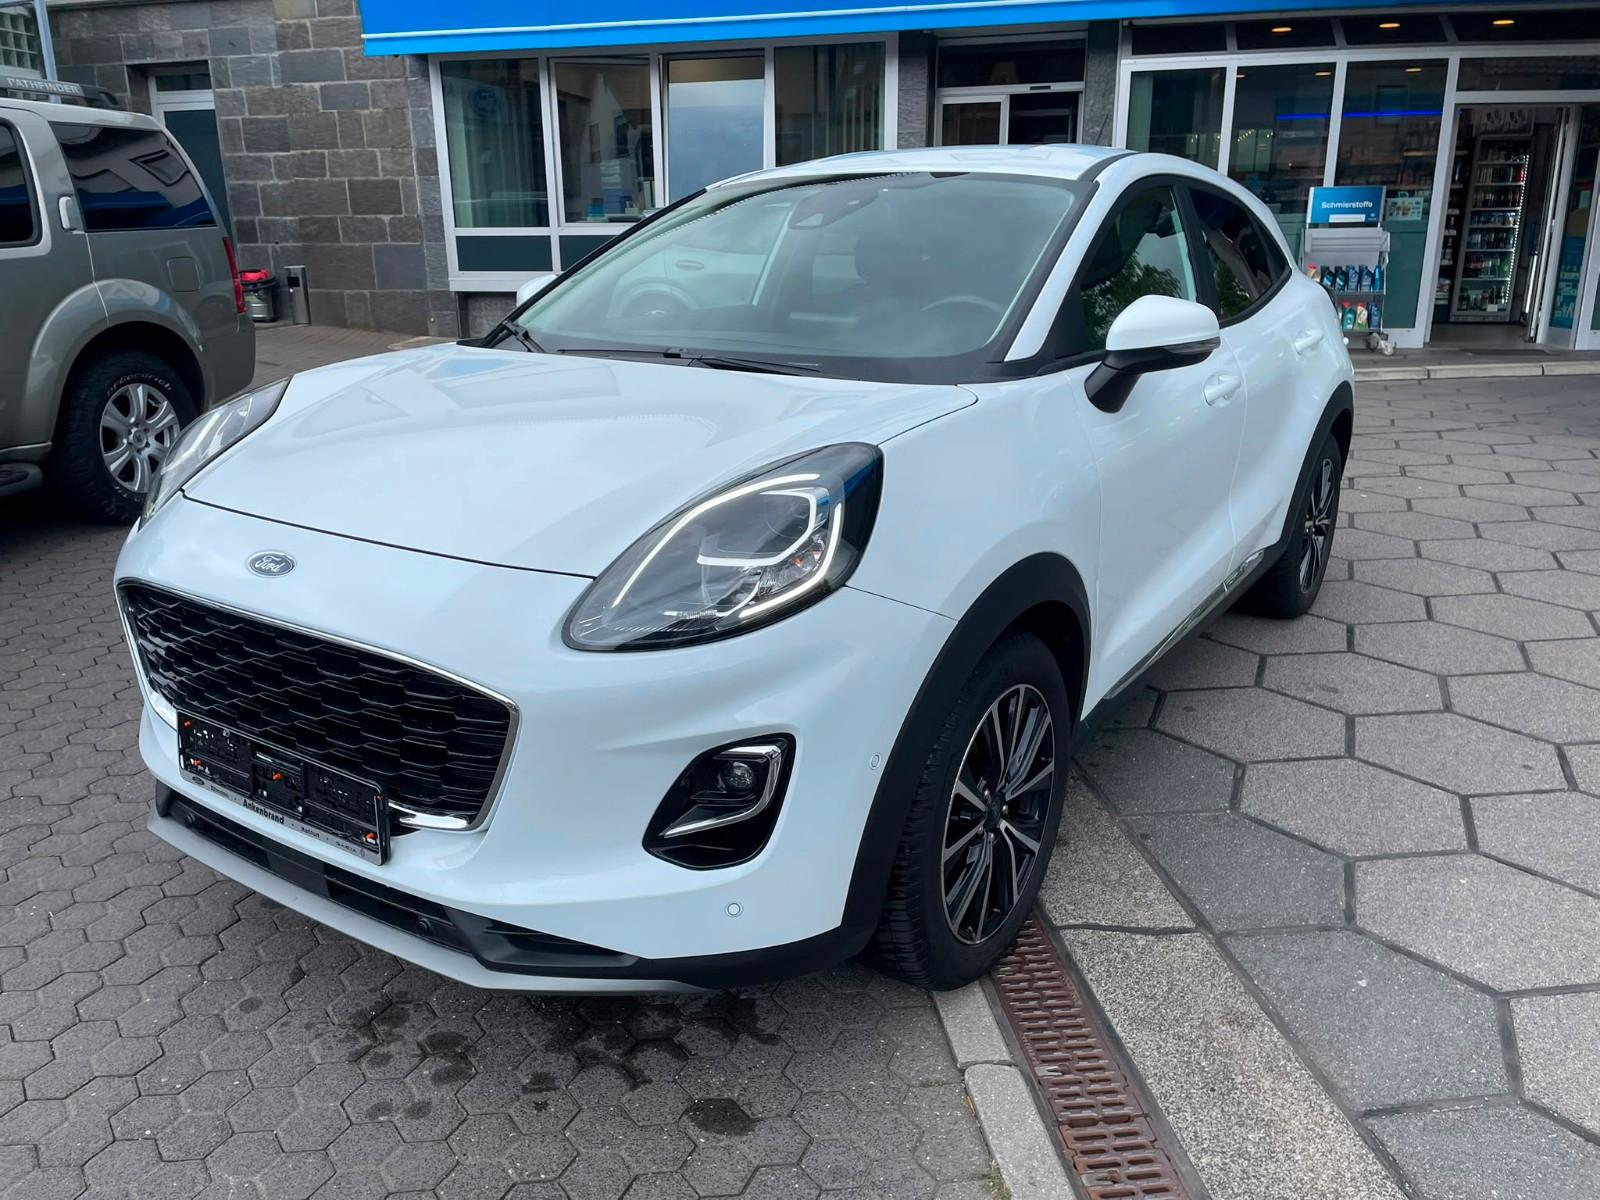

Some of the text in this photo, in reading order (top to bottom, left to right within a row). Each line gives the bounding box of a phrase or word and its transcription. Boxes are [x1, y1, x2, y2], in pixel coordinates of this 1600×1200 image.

[8, 78, 80, 94] PATHFINDER
[1321, 201, 1373, 209] Schmierstoffe
[255, 553, 286, 572] Ford
[243, 799, 285, 825] Ankenbrand
